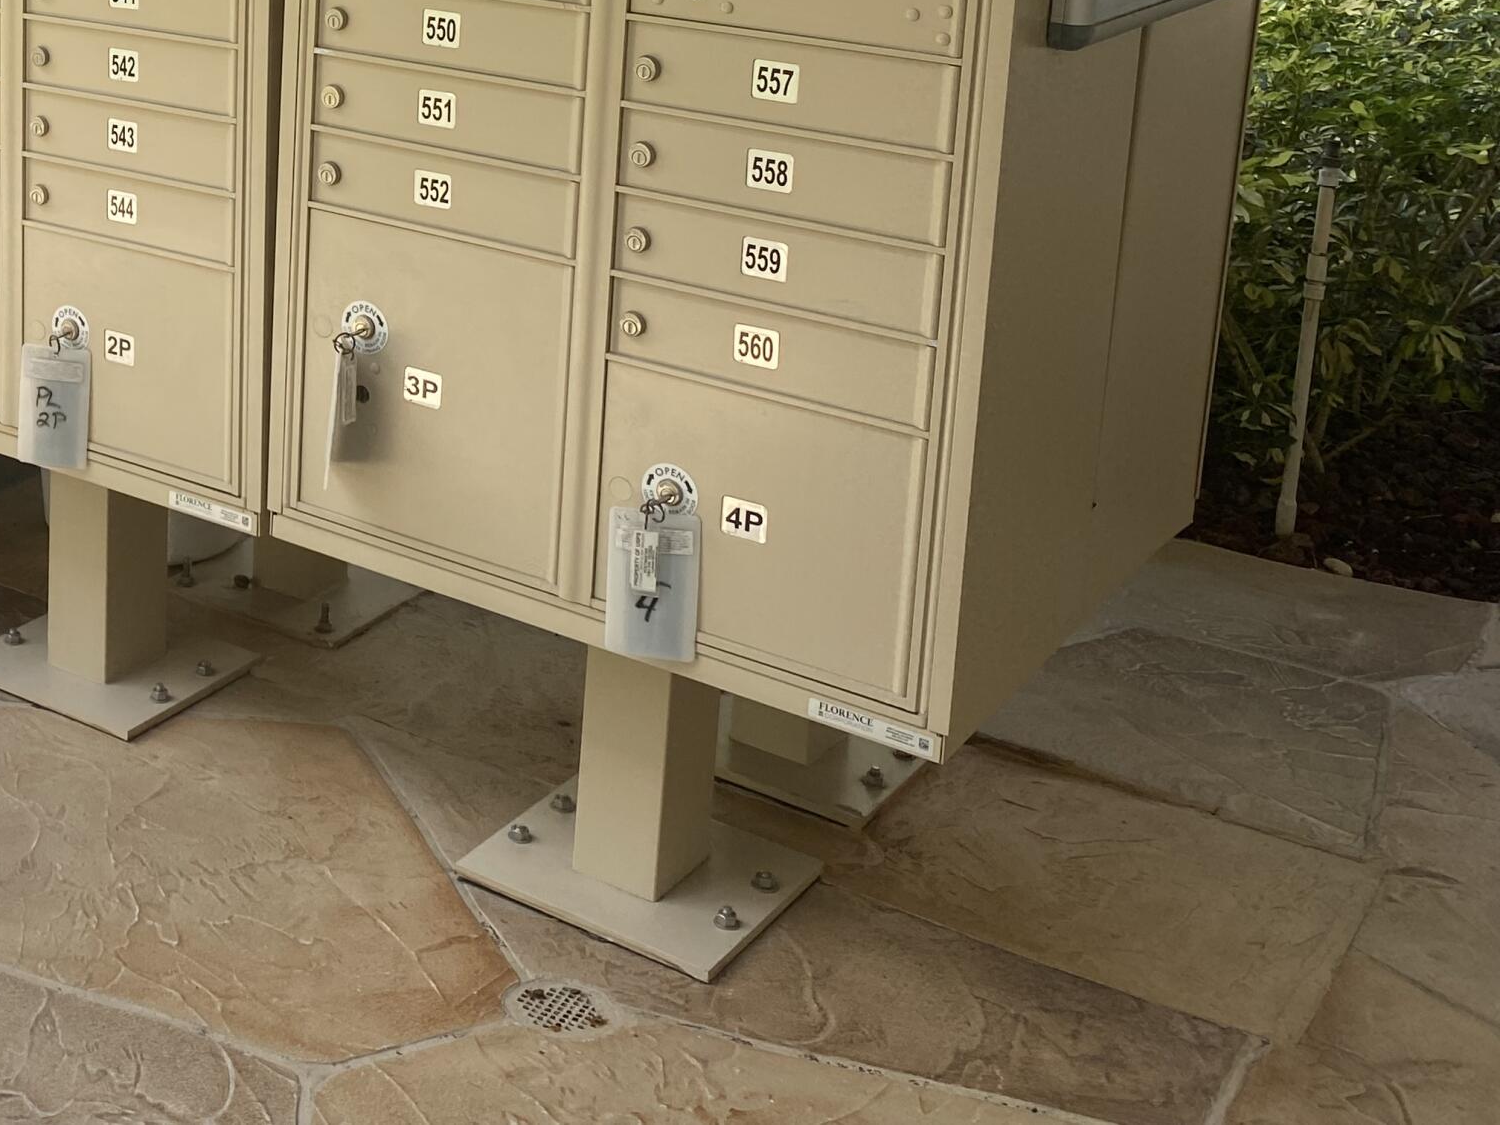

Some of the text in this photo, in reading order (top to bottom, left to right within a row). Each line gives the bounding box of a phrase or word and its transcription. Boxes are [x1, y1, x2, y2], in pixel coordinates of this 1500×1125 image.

[426, 16, 456, 43] 550
[111, 54, 136, 78] 542
[756, 66, 794, 96] 557
[421, 95, 452, 123] 551
[110, 124, 135, 148] 543
[751, 156, 788, 187] 558
[419, 177, 449, 204] 552
[110, 195, 134, 219] 544
[744, 243, 781, 275] 559
[58, 308, 79, 320] OPEN
[351, 303, 377, 317] OPEN
[107, 335, 131, 357] 2P
[738, 331, 774, 363] 560
[406, 375, 438, 399] 3P
[35, 411, 68, 430] 2P
[654, 466, 686, 482] OPEN
[174, 492, 213, 512] FLORENCE
[725, 507, 764, 533] 4P
[819, 701, 875, 728] FLORENCE
